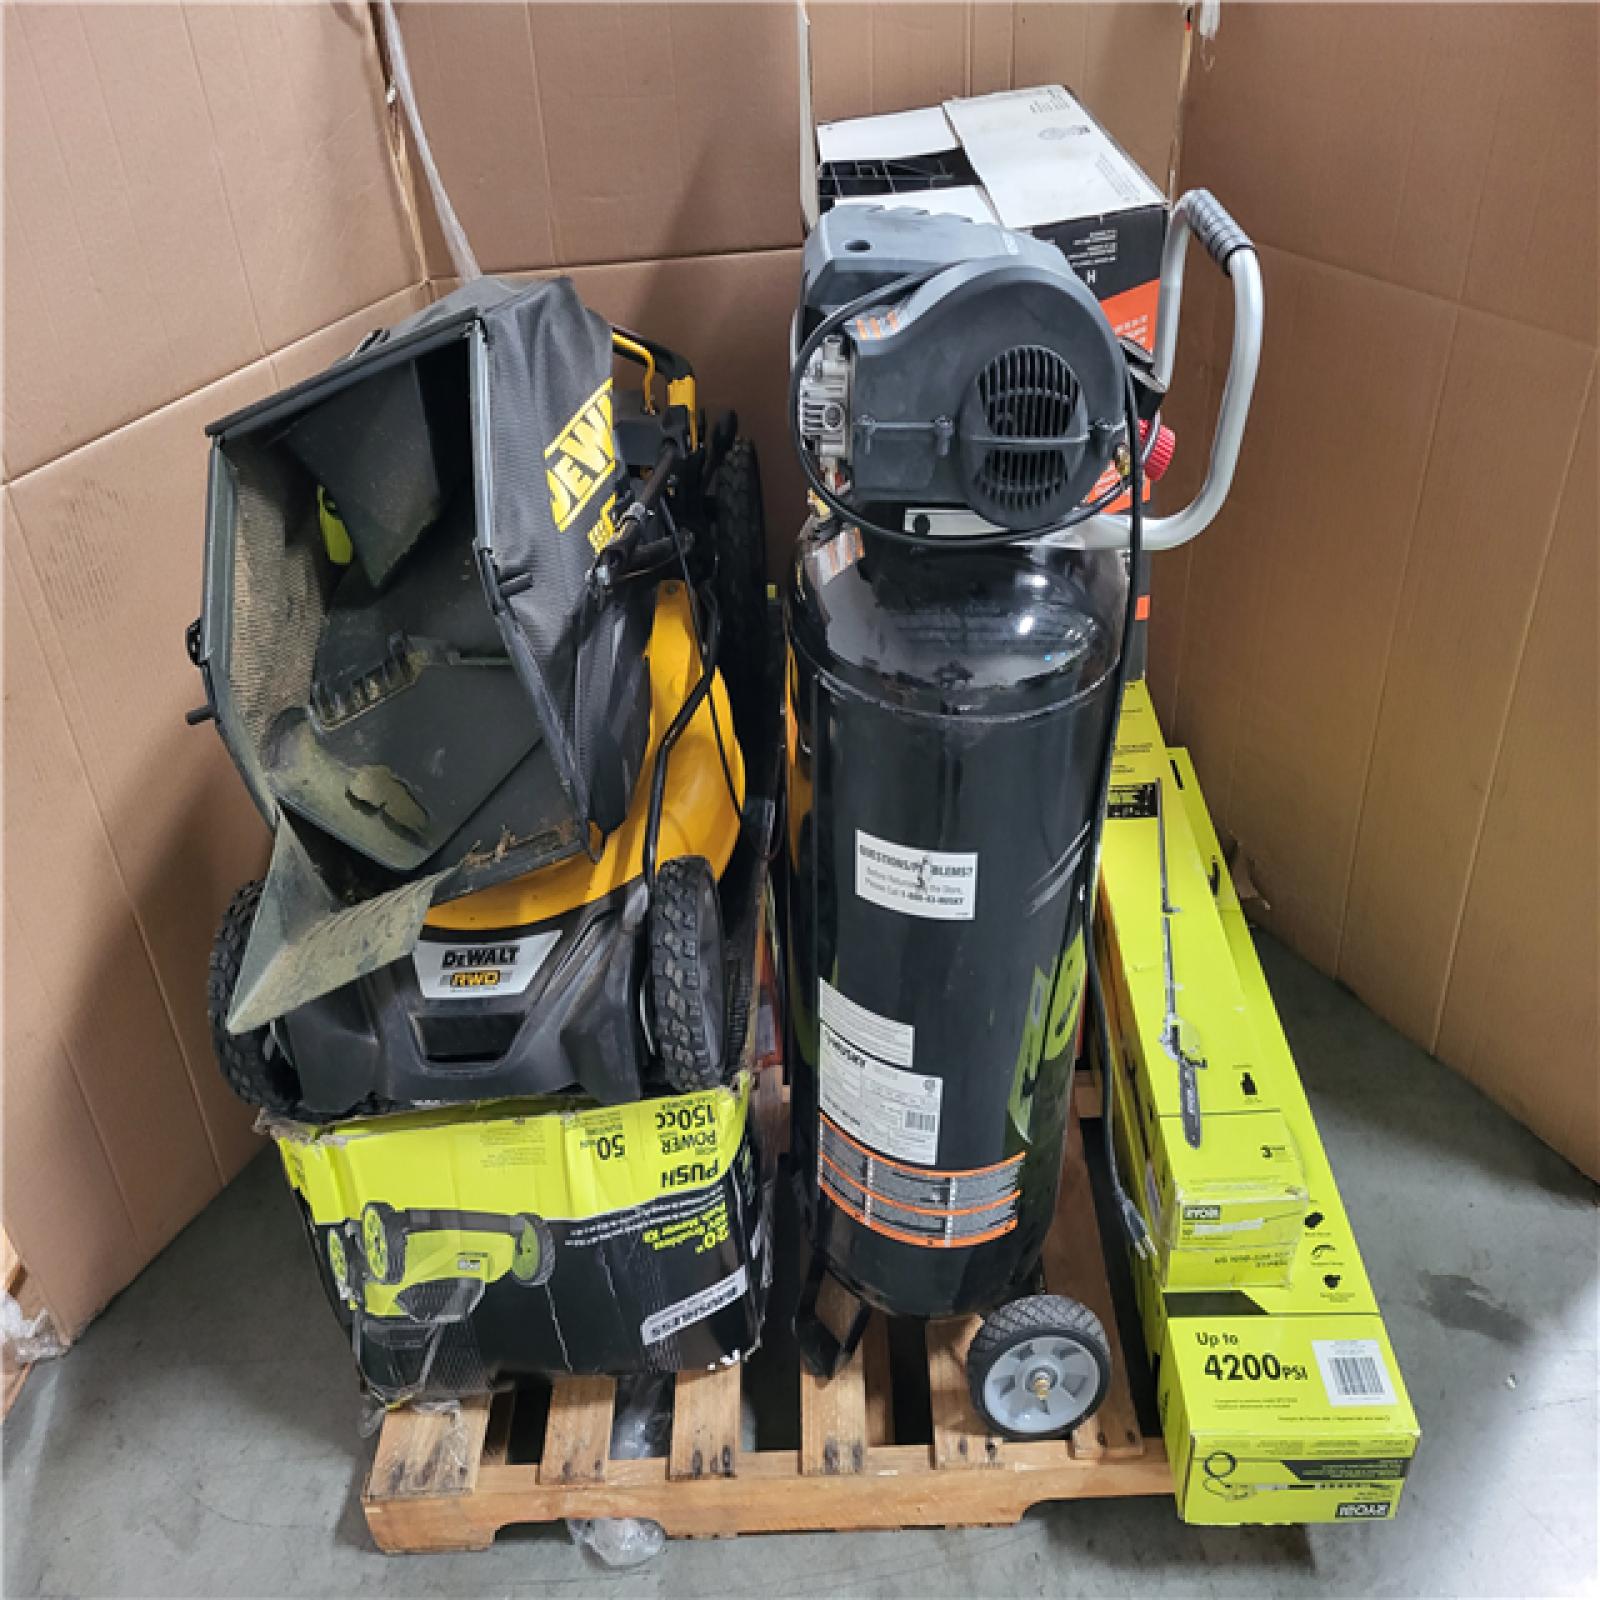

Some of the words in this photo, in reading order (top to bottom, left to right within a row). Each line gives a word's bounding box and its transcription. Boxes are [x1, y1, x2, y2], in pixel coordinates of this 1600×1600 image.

[597, 1134, 625, 1160] 50
[1195, 1332, 1220, 1349] Up
[1222, 1332, 1239, 1346] to
[1204, 1354, 1281, 1381] 4200
